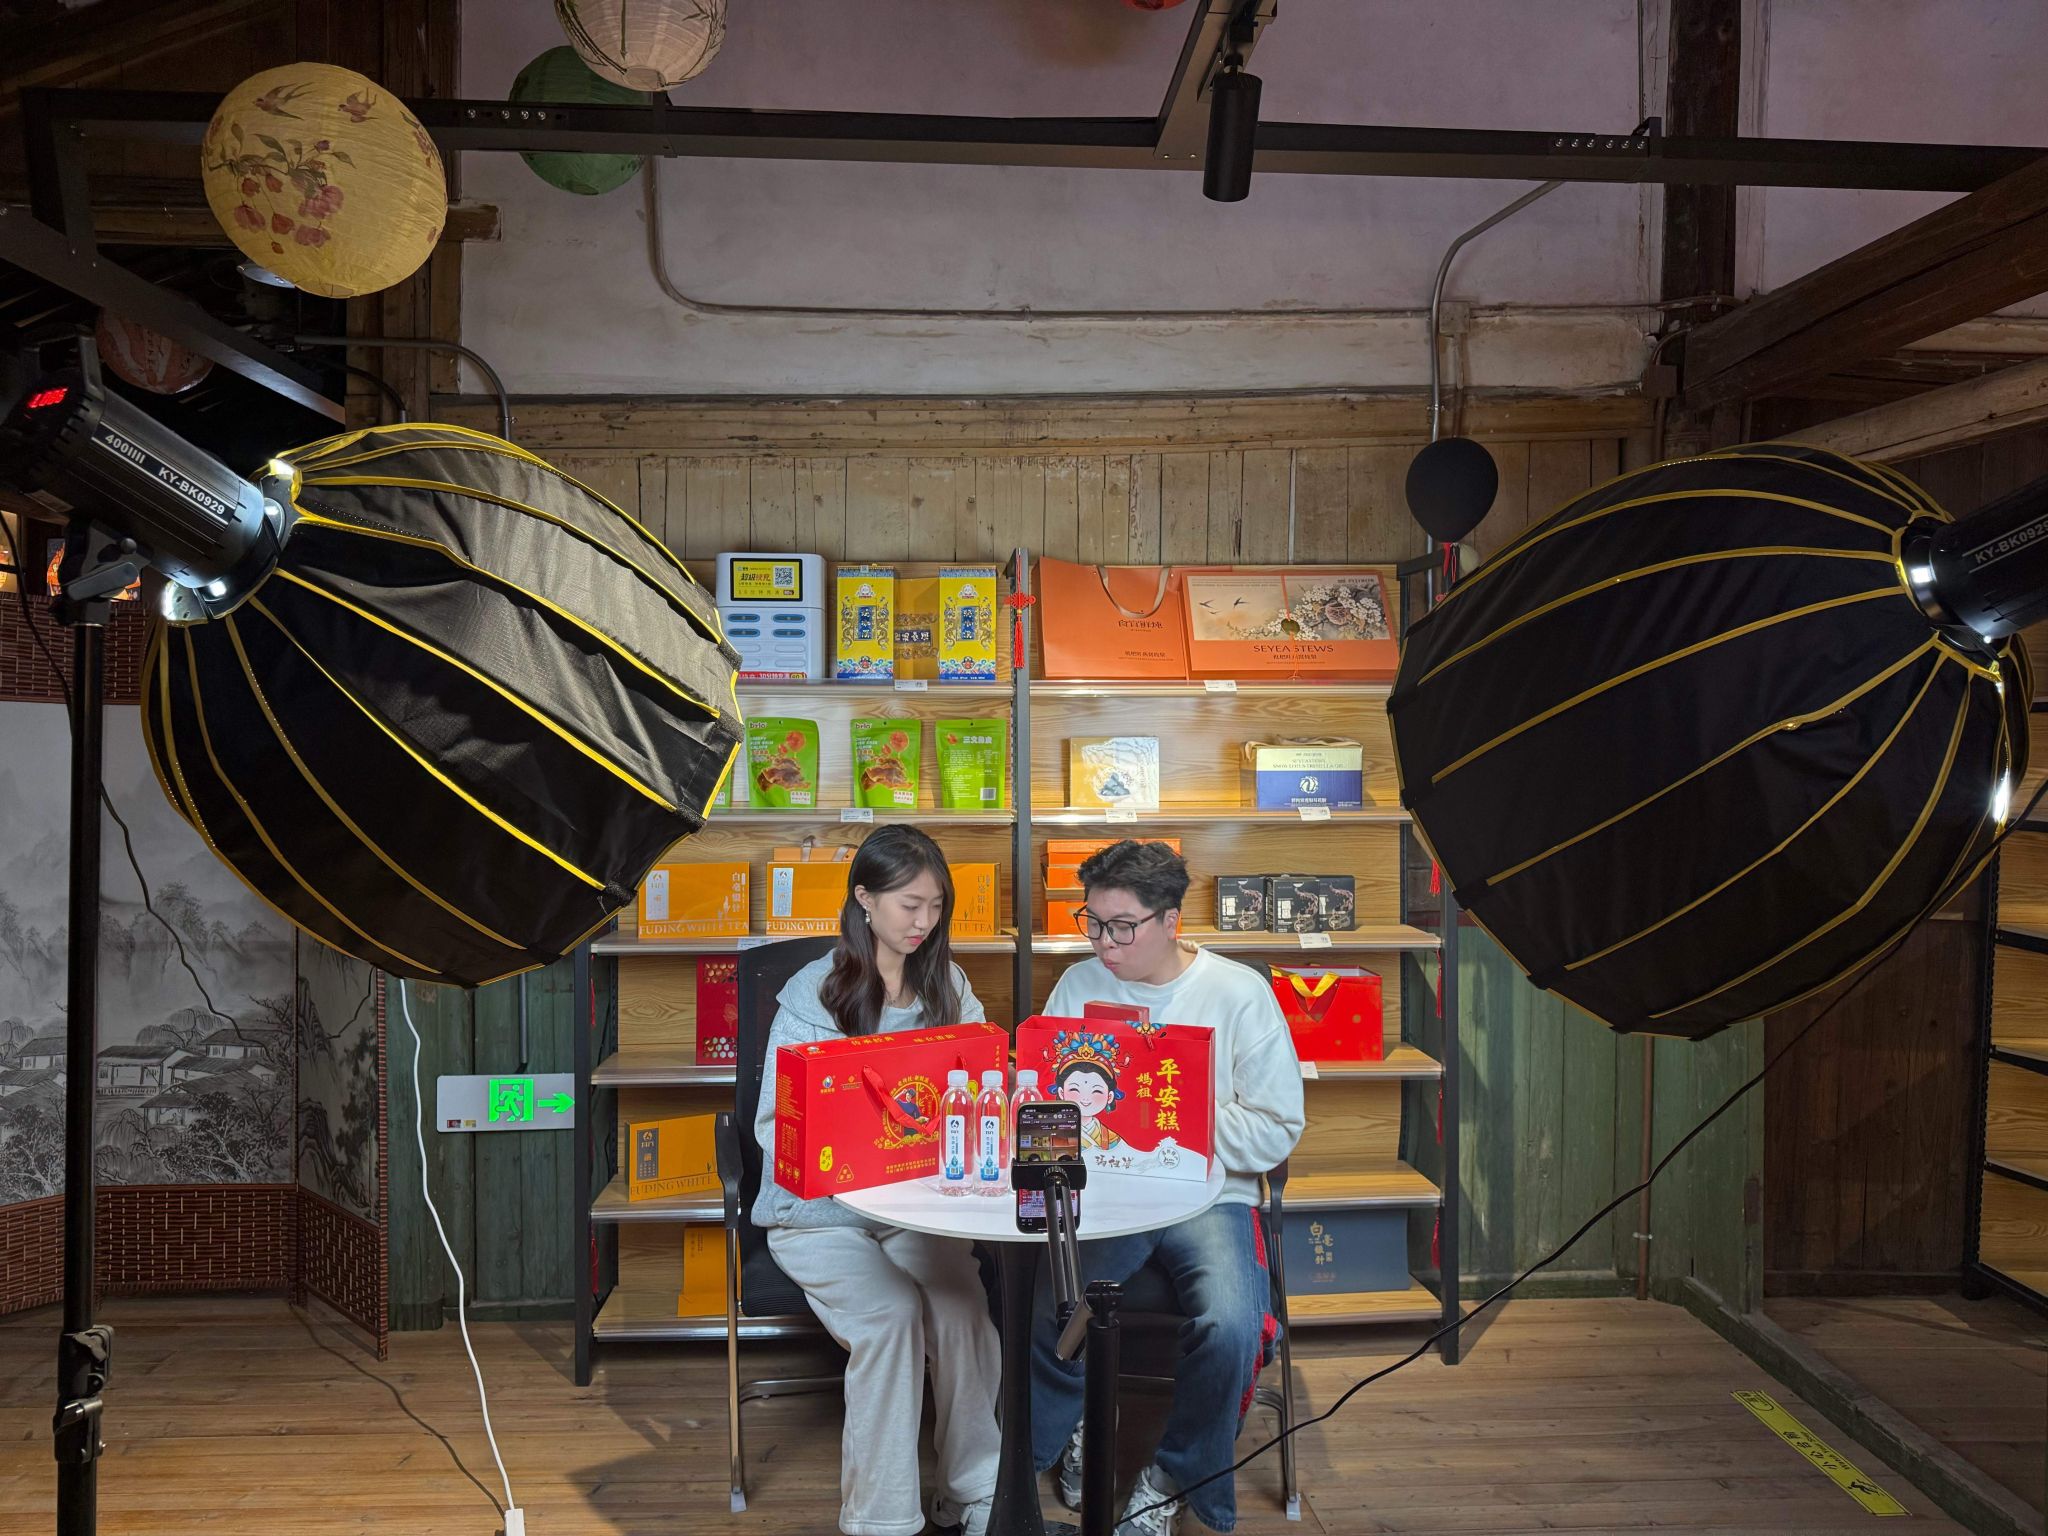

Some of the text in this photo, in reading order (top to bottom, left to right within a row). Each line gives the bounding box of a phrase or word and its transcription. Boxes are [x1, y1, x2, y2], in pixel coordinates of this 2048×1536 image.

[158, 467, 225, 515] KY-BK0929
[1253, 645, 1334, 653] SEYEA STEWS
[639, 921, 749, 935] FUDING WHITE TEA
[767, 921, 839, 931] FUDING WHIT
[953, 922, 993, 933] ITE TEA
[1136, 1072, 1153, 1098] 媽祖
[1154, 1058, 1181, 1131] 平安糕
[630, 1175, 711, 1195] FUDING WHITE
